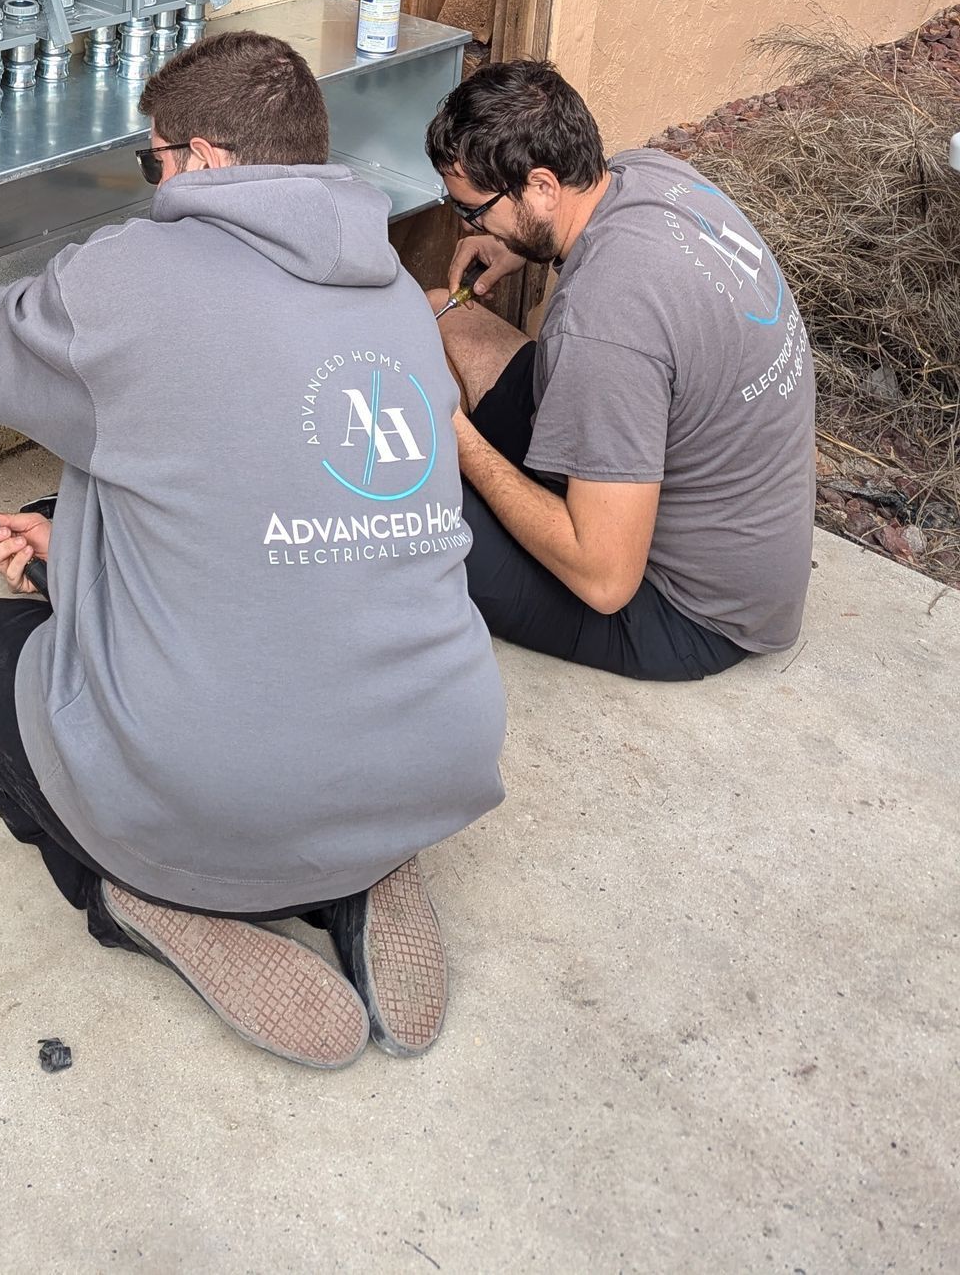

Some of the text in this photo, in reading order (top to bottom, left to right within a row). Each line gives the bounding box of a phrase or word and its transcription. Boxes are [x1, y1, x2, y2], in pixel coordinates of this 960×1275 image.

[301, 350, 402, 446] ADVANCED HOME
[340, 388, 427, 463] AH
[263, 502, 462, 545] ADVANCED HOME
[268, 531, 471, 565] ELECTRICAL SOLUTIONS
